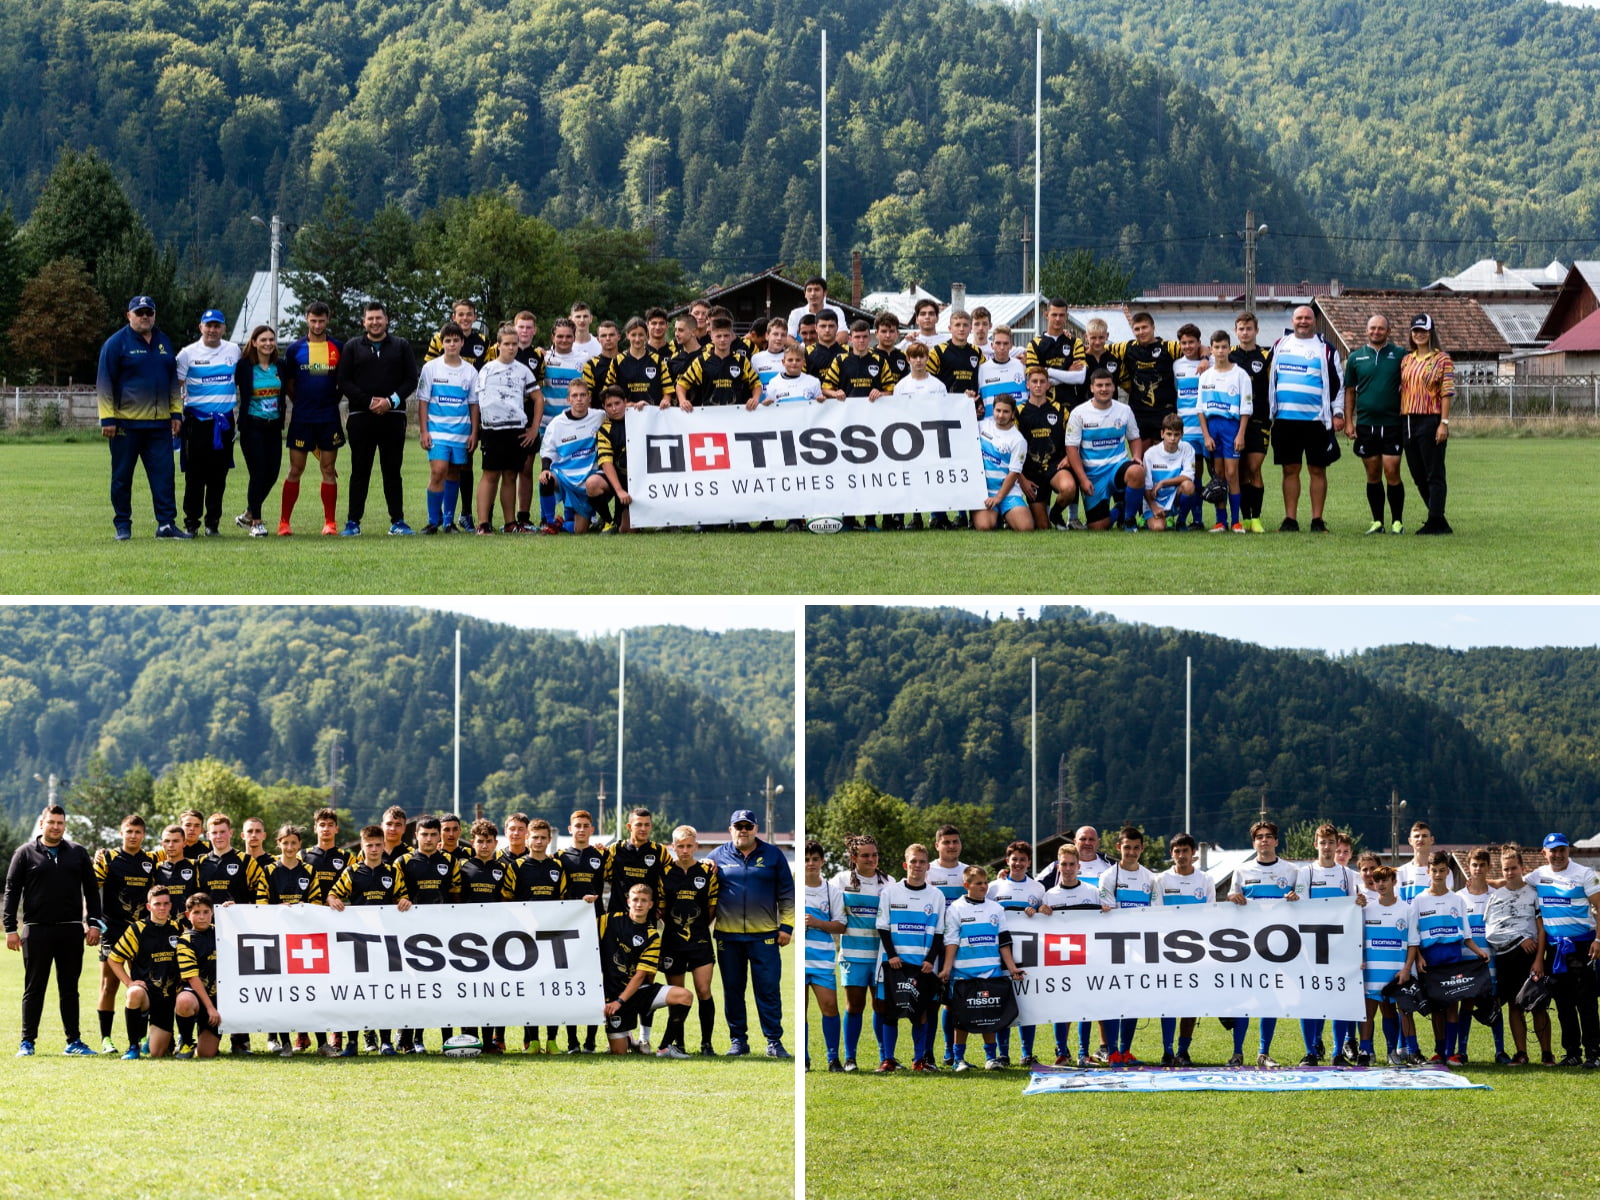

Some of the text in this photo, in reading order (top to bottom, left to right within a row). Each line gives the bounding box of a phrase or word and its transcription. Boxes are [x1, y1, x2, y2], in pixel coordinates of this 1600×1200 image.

[735, 420, 962, 468] TISSOT
[648, 468, 969, 499] SWISS WATCHES SINCE 1853
[811, 523, 841, 531] GILBERT
[336, 930, 580, 972] TISSOT
[1095, 924, 1345, 965] TISSOT
[239, 981, 586, 1004] SWISS WATCHES SINCE 1853
[1013, 973, 1346, 996] WISS WATCHES SINCE 1853
[966, 997, 1001, 1006] TISSOT
